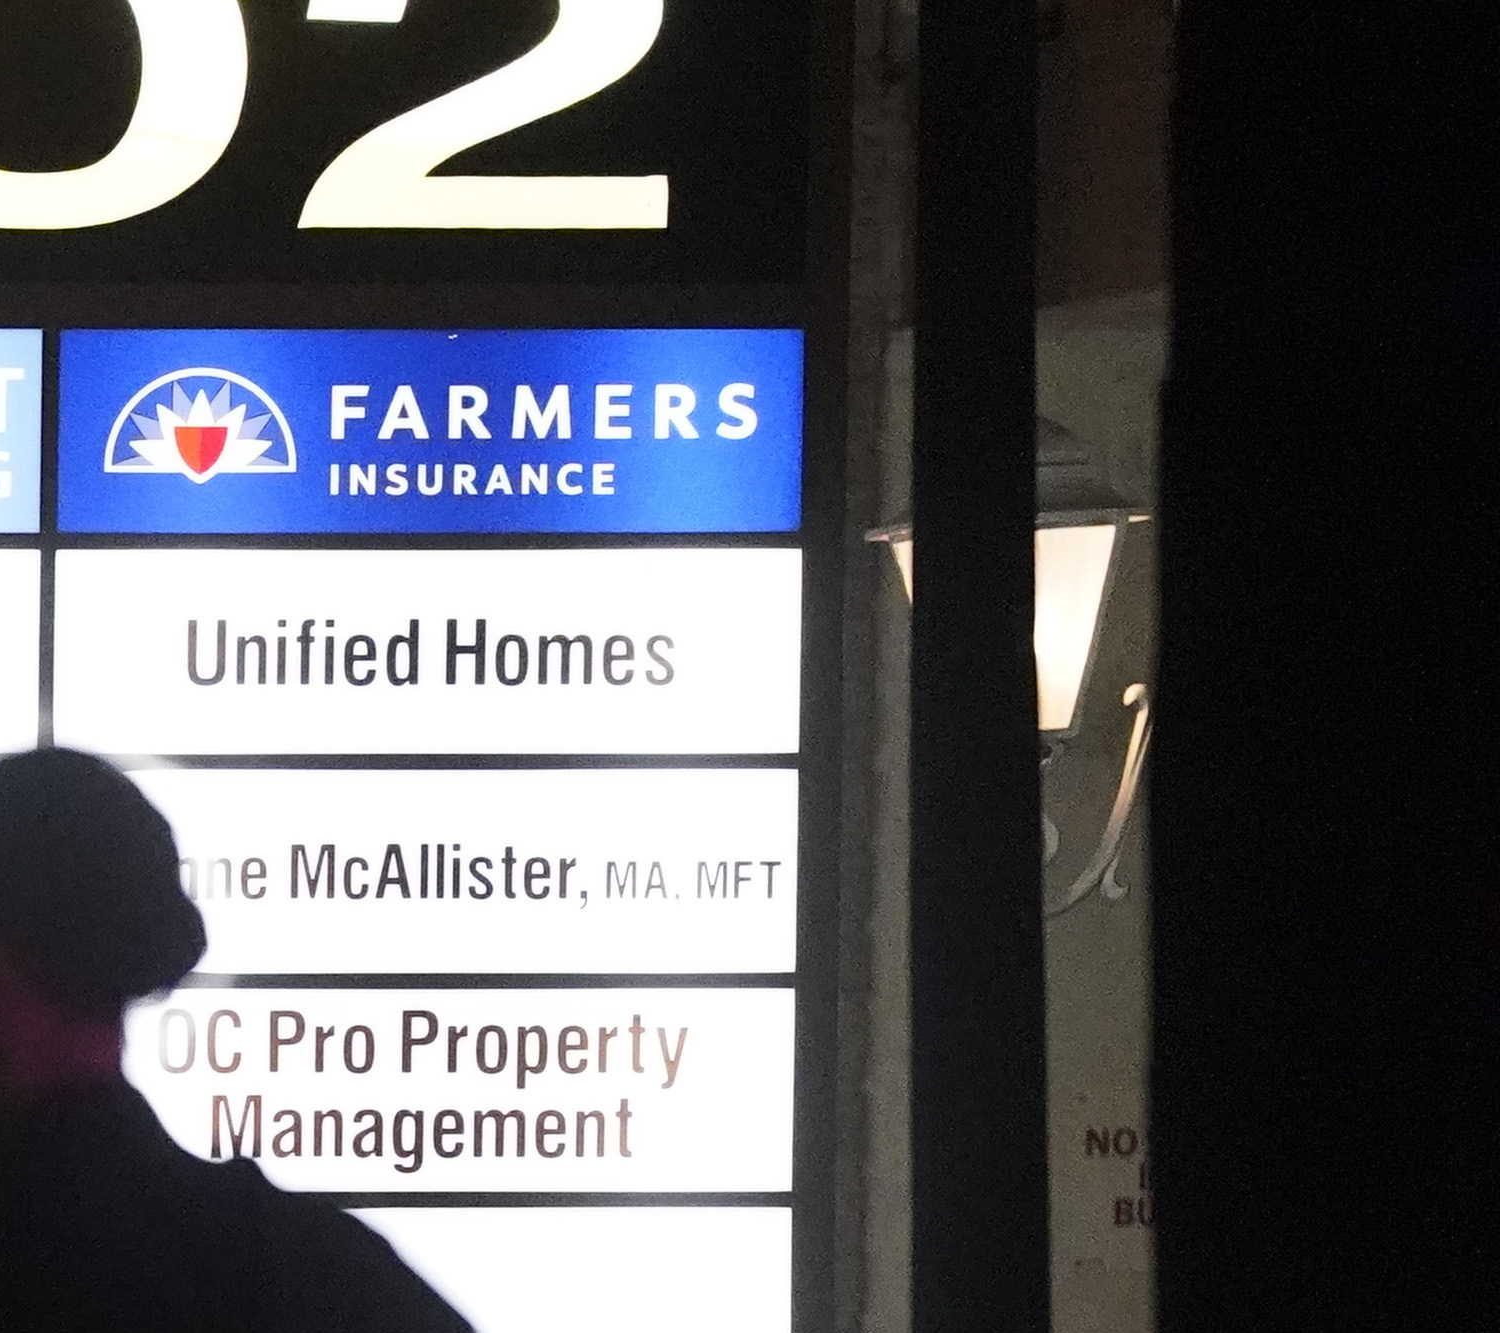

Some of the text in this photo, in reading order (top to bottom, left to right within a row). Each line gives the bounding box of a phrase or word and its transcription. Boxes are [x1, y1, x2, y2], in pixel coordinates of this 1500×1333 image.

[330, 383, 759, 440] FARMERS
[329, 463, 617, 496] INSURANCE
[187, 619, 676, 686] Unified Homes
[178, 856, 267, 900] nne
[290, 843, 589, 910] McAllister,
[697, 861, 782, 899] MFT
[158, 1008, 690, 1090] OC Pro Property
[209, 1095, 633, 1174] Management
[1084, 1127, 1139, 1157] NO
